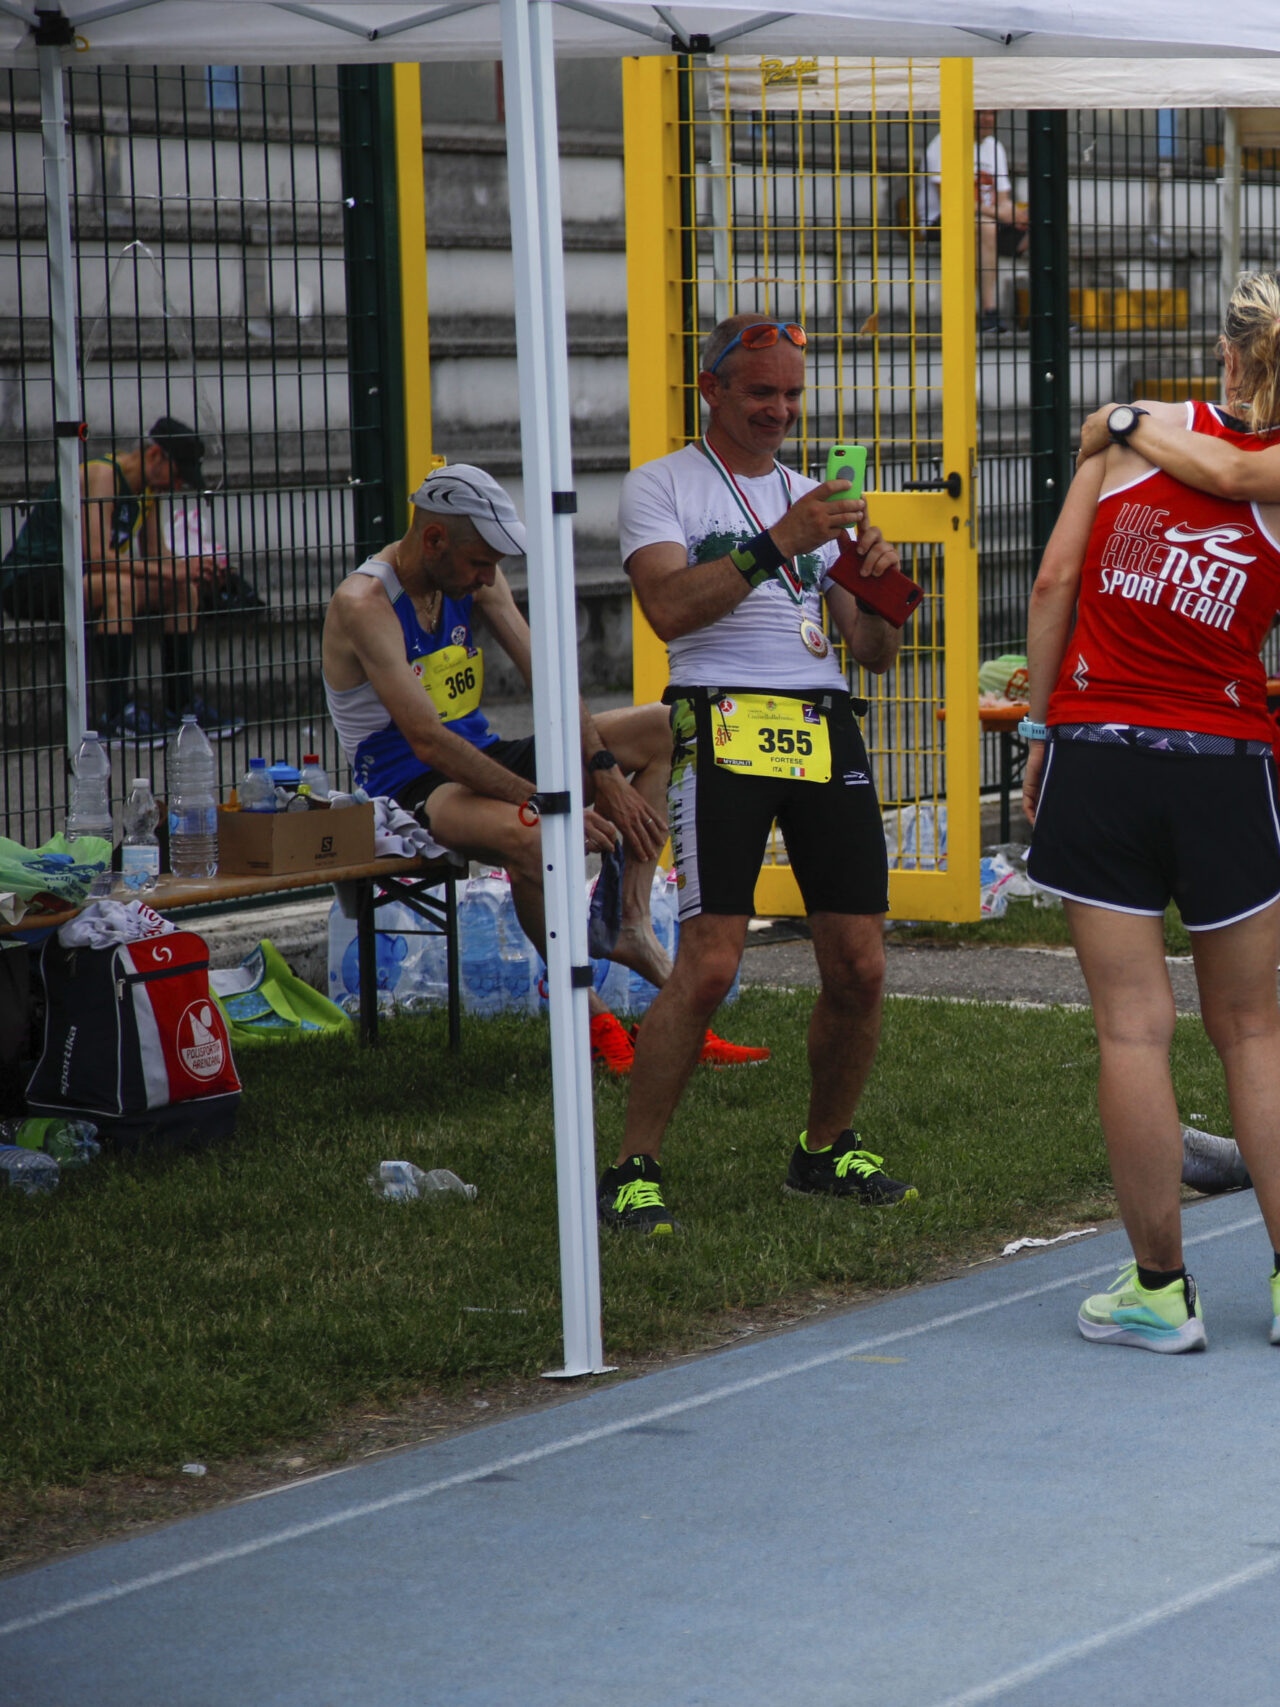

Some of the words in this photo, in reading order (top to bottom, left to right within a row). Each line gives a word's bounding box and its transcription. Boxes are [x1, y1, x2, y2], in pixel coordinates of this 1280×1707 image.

[1113, 502, 1170, 540] WE
[1098, 568, 1168, 606] SPORT
[1170, 586, 1235, 632] TEAM
[445, 666, 475, 699] 366
[758, 728, 813, 756] 355
[60, 1025, 78, 1097] sportika
